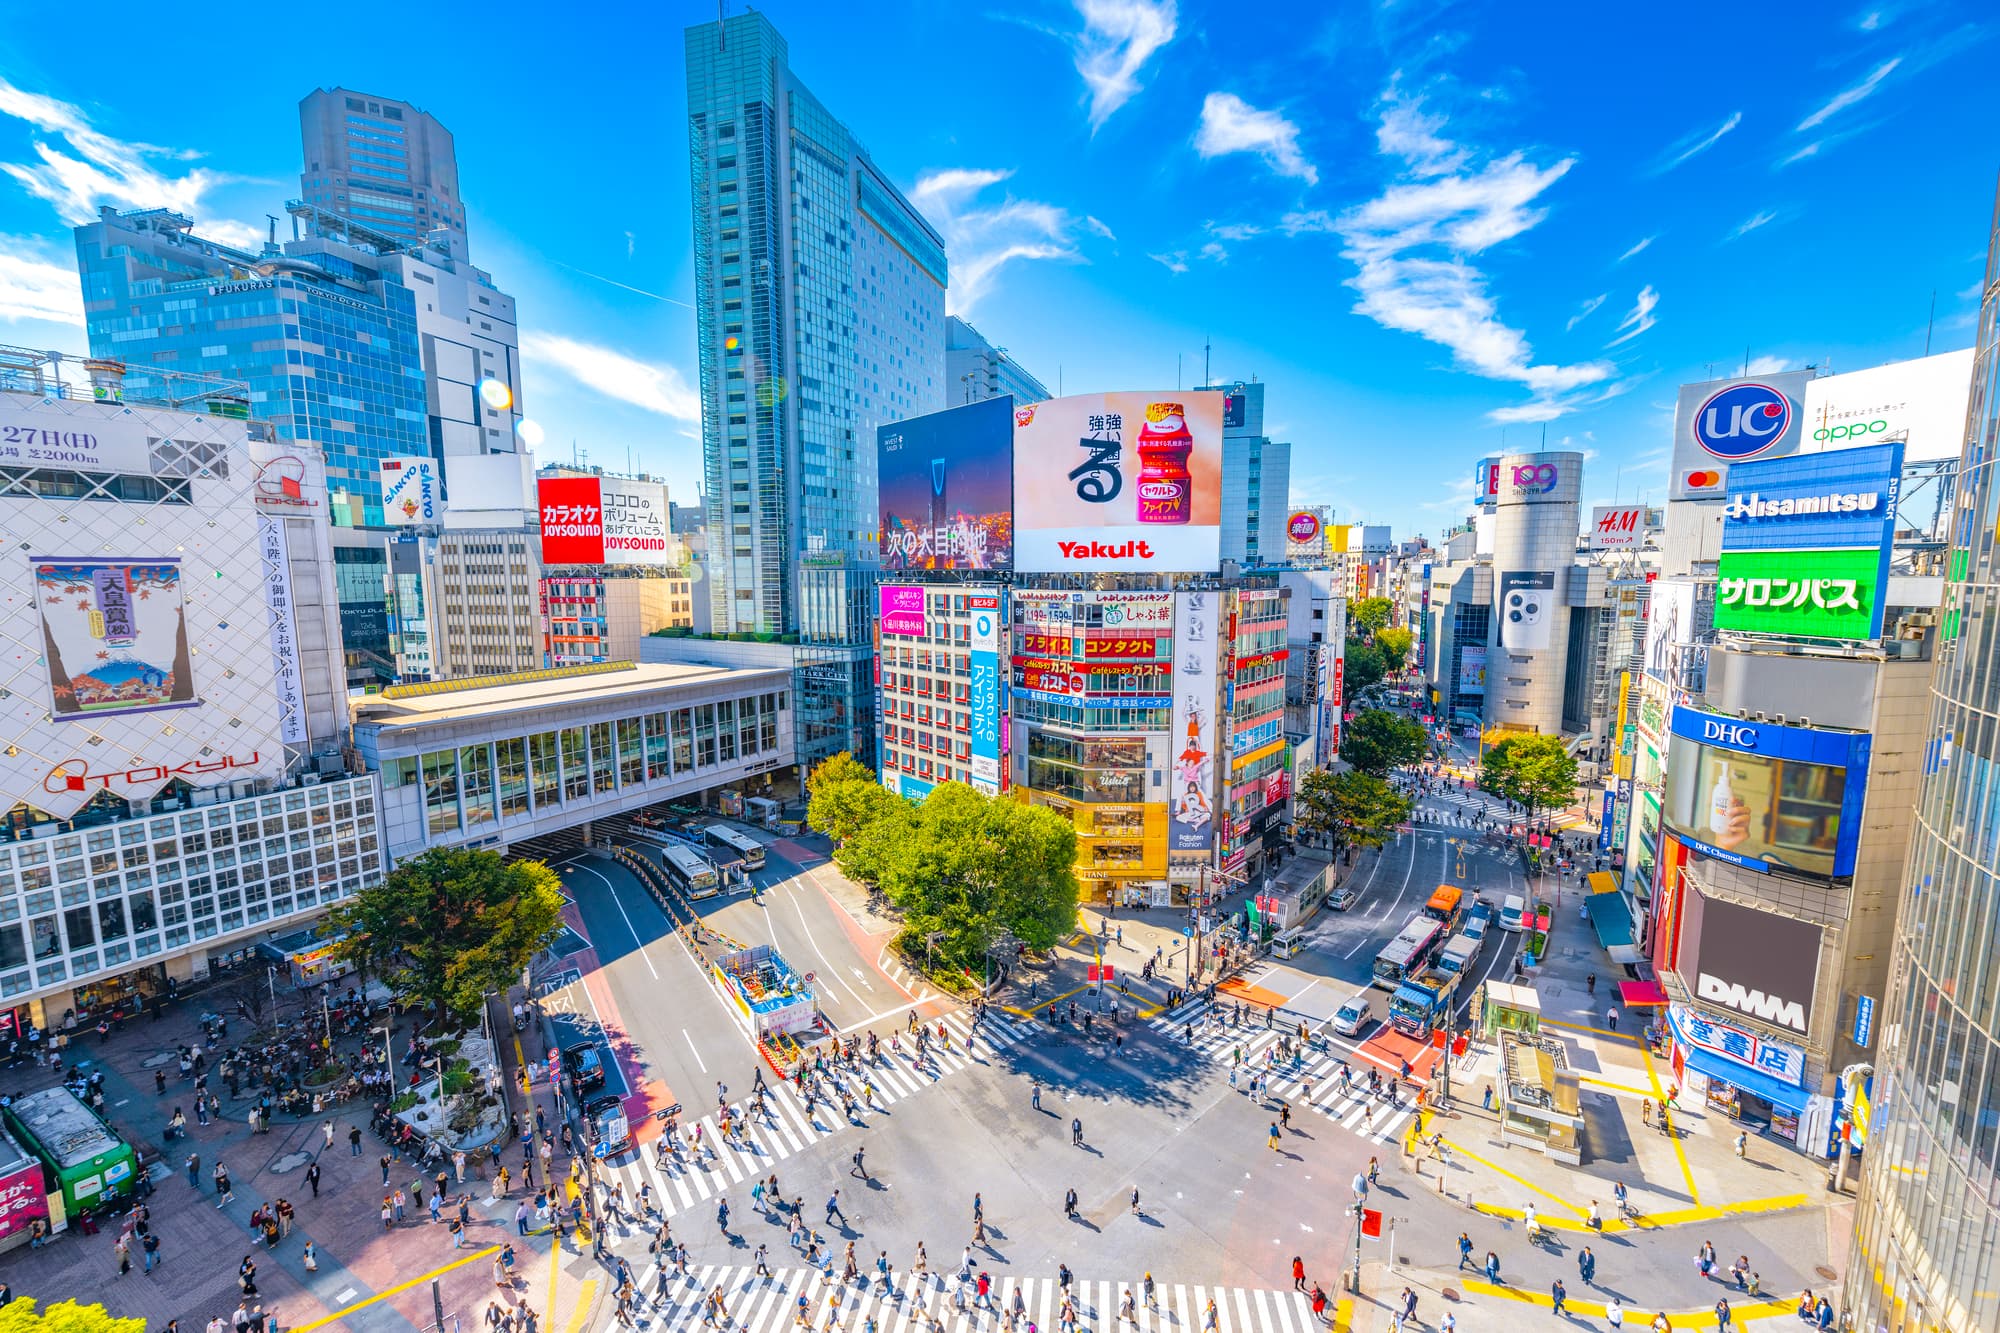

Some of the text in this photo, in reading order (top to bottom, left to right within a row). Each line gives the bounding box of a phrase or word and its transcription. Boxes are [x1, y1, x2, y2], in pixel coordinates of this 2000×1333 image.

[219, 280, 273, 294] FUKURAS
[306, 286, 336, 301] TOKYU
[1705, 402, 1779, 438] UC
[3, 426, 97, 449] 27日(日)
[1814, 420, 1887, 443] oppo
[28, 448, 99, 464] 芝2000m
[384, 465, 417, 505] SANKYO
[1511, 463, 1558, 494] 109
[420, 463, 435, 519] SANKYO
[1144, 486, 1174, 497] ヤクルト
[1884, 478, 1899, 520] サロンパス
[255, 497, 319, 507] TOKYU
[603, 493, 650, 509] ココロの
[1724, 492, 1878, 519] Hisamitsu
[543, 504, 599, 523] カラオケ
[604, 508, 663, 525] ボリューム、
[1598, 510, 1640, 533] H&M
[544, 525, 600, 537] JOYSOUND
[605, 537, 665, 550] JOYSOUND
[887, 524, 988, 557] 次の大目的地
[1058, 540, 1154, 559] Yakult
[1601, 537, 1624, 545] 150m
[1096, 593, 1170, 602] しゃぶしゃぶバイキング
[1720, 578, 1860, 610] サロンパス
[1126, 606, 1170, 621] しゃぶ葉
[1026, 635, 1071, 653] プライス
[1086, 640, 1153, 654] コンタクト
[1051, 661, 1074, 674] ガスト
[1132, 664, 1164, 677] ガスト
[1015, 672, 1025, 682] 7F
[1040, 673, 1068, 691] ガスト
[973, 664, 985, 740] アイシティ
[986, 665, 995, 742] コンタクトの
[1704, 720, 1758, 747] DHC
[87, 752, 259, 788] TOKYU
[1265, 811, 1281, 829] LUSH
[1179, 834, 1204, 842] Rakuten
[1695, 842, 1742, 864] DHC Channel
[1698, 972, 1806, 1031] DMM
